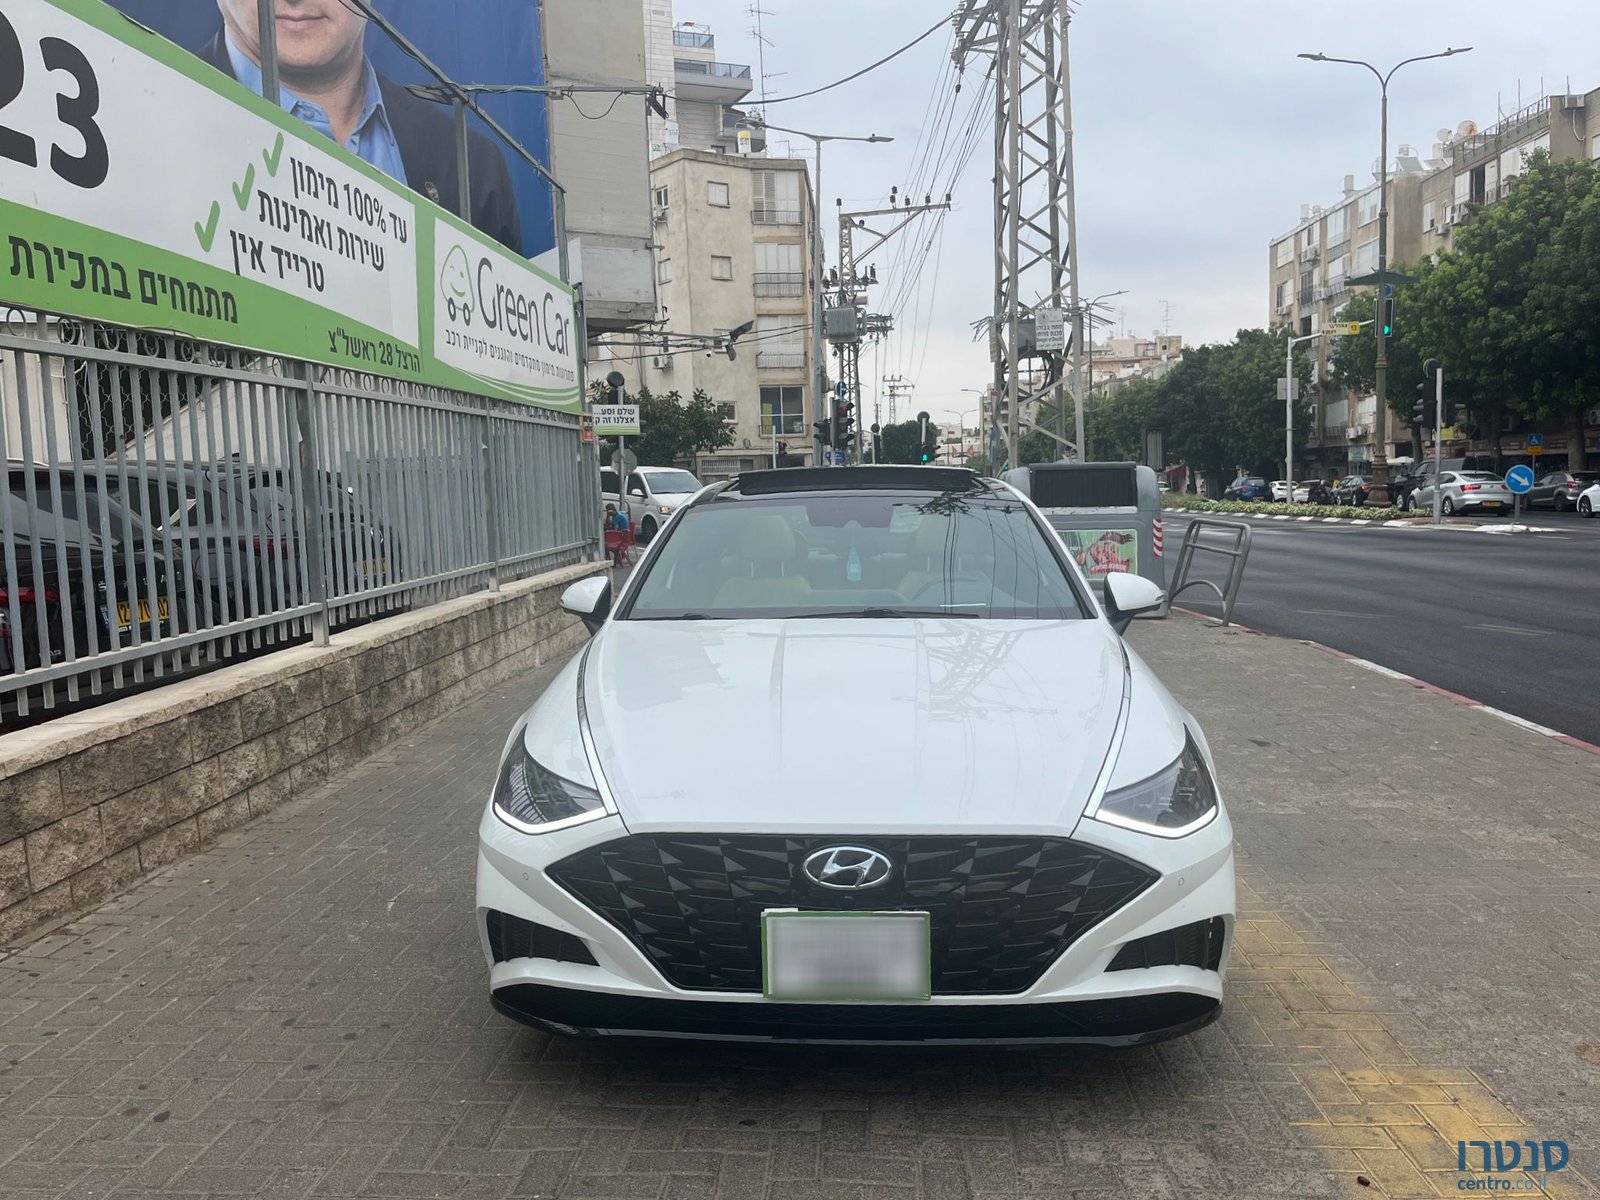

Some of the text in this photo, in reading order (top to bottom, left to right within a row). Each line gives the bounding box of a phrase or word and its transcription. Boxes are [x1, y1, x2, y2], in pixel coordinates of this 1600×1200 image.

[290, 156, 408, 244] עד 100% מימון
[257, 189, 385, 272] שירות ואמינות
[229, 229, 325, 292] טרייד אין
[8, 235, 238, 324] מתמחים במכירת
[477, 257, 570, 357] Green Car
[445, 329, 461, 348] רכב
[463, 335, 487, 358] לקניית
[328, 327, 421, 374] הרצל 28 ראשל"צ
[489, 344, 513, 364] והוגנים
[515, 352, 541, 373] מתקדמים
[602, 416, 611, 424] זה
[613, 416, 635, 424] אצלנו
[617, 407, 635, 415] שלם
